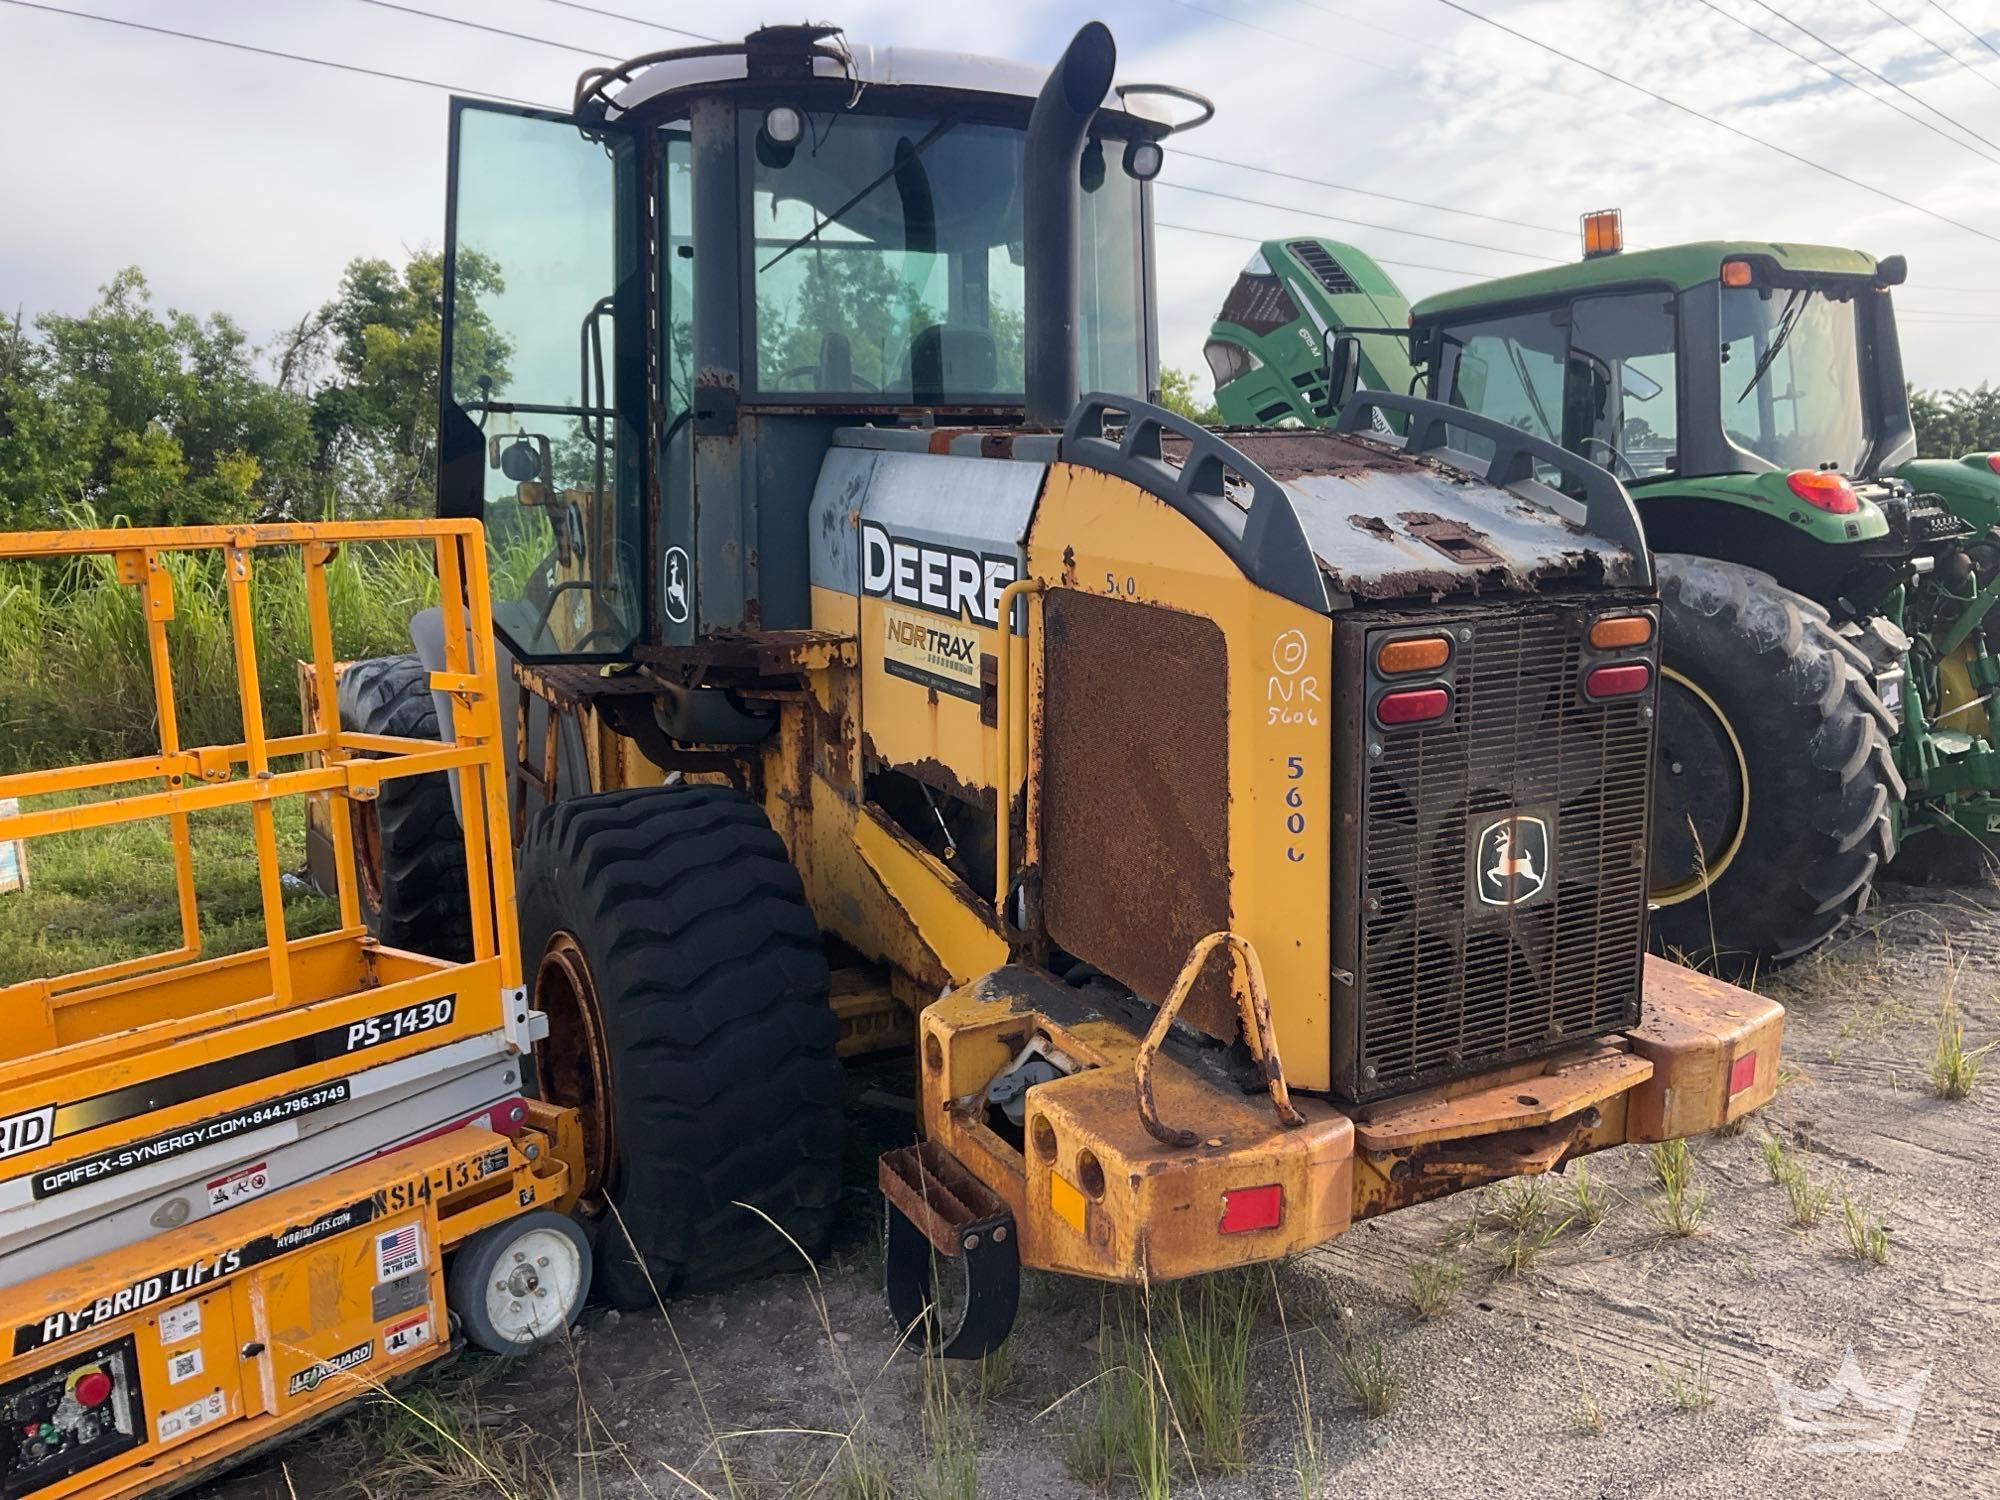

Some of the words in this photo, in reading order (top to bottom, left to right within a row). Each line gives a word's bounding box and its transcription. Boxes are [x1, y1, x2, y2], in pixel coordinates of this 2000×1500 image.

[863, 525, 1015, 626] DEERE
[888, 617, 975, 664] NORTRAX
[1267, 706, 1319, 726] 5606
[346, 999, 452, 1051] PS-1430
[383, 1268, 391, 1276] IN
[391, 1262, 403, 1272] THE
[404, 1257, 418, 1268] USA
[42, 1277, 162, 1343] HY-BRID
